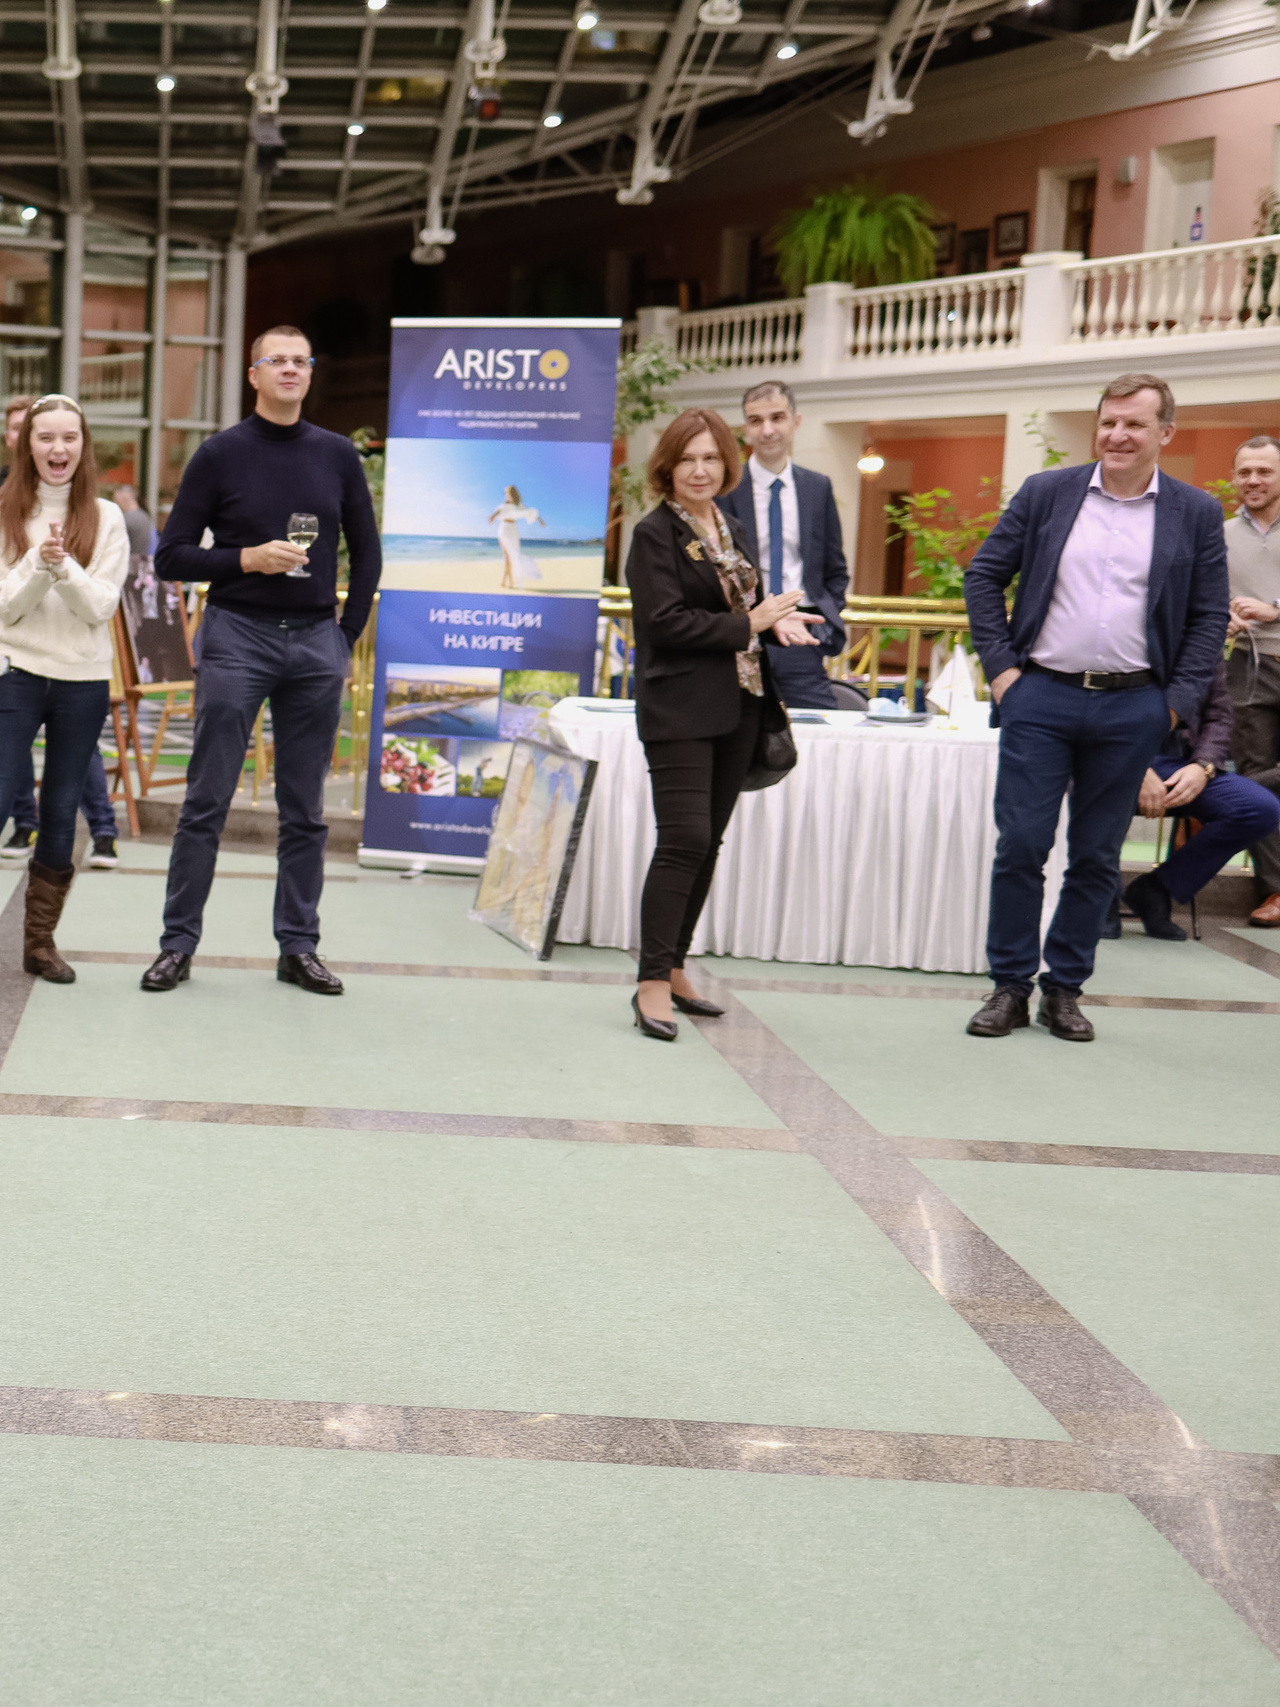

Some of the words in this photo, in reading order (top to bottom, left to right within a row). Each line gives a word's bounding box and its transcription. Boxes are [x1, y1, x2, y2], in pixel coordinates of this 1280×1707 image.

[434, 348, 569, 380] ARISTO
[462, 380, 567, 392] DEVELOPERS
[429, 608, 542, 629] ИНВЕСТИЦИИ
[443, 633, 468, 649] НА
[471, 635, 524, 652] КИПРЕ
